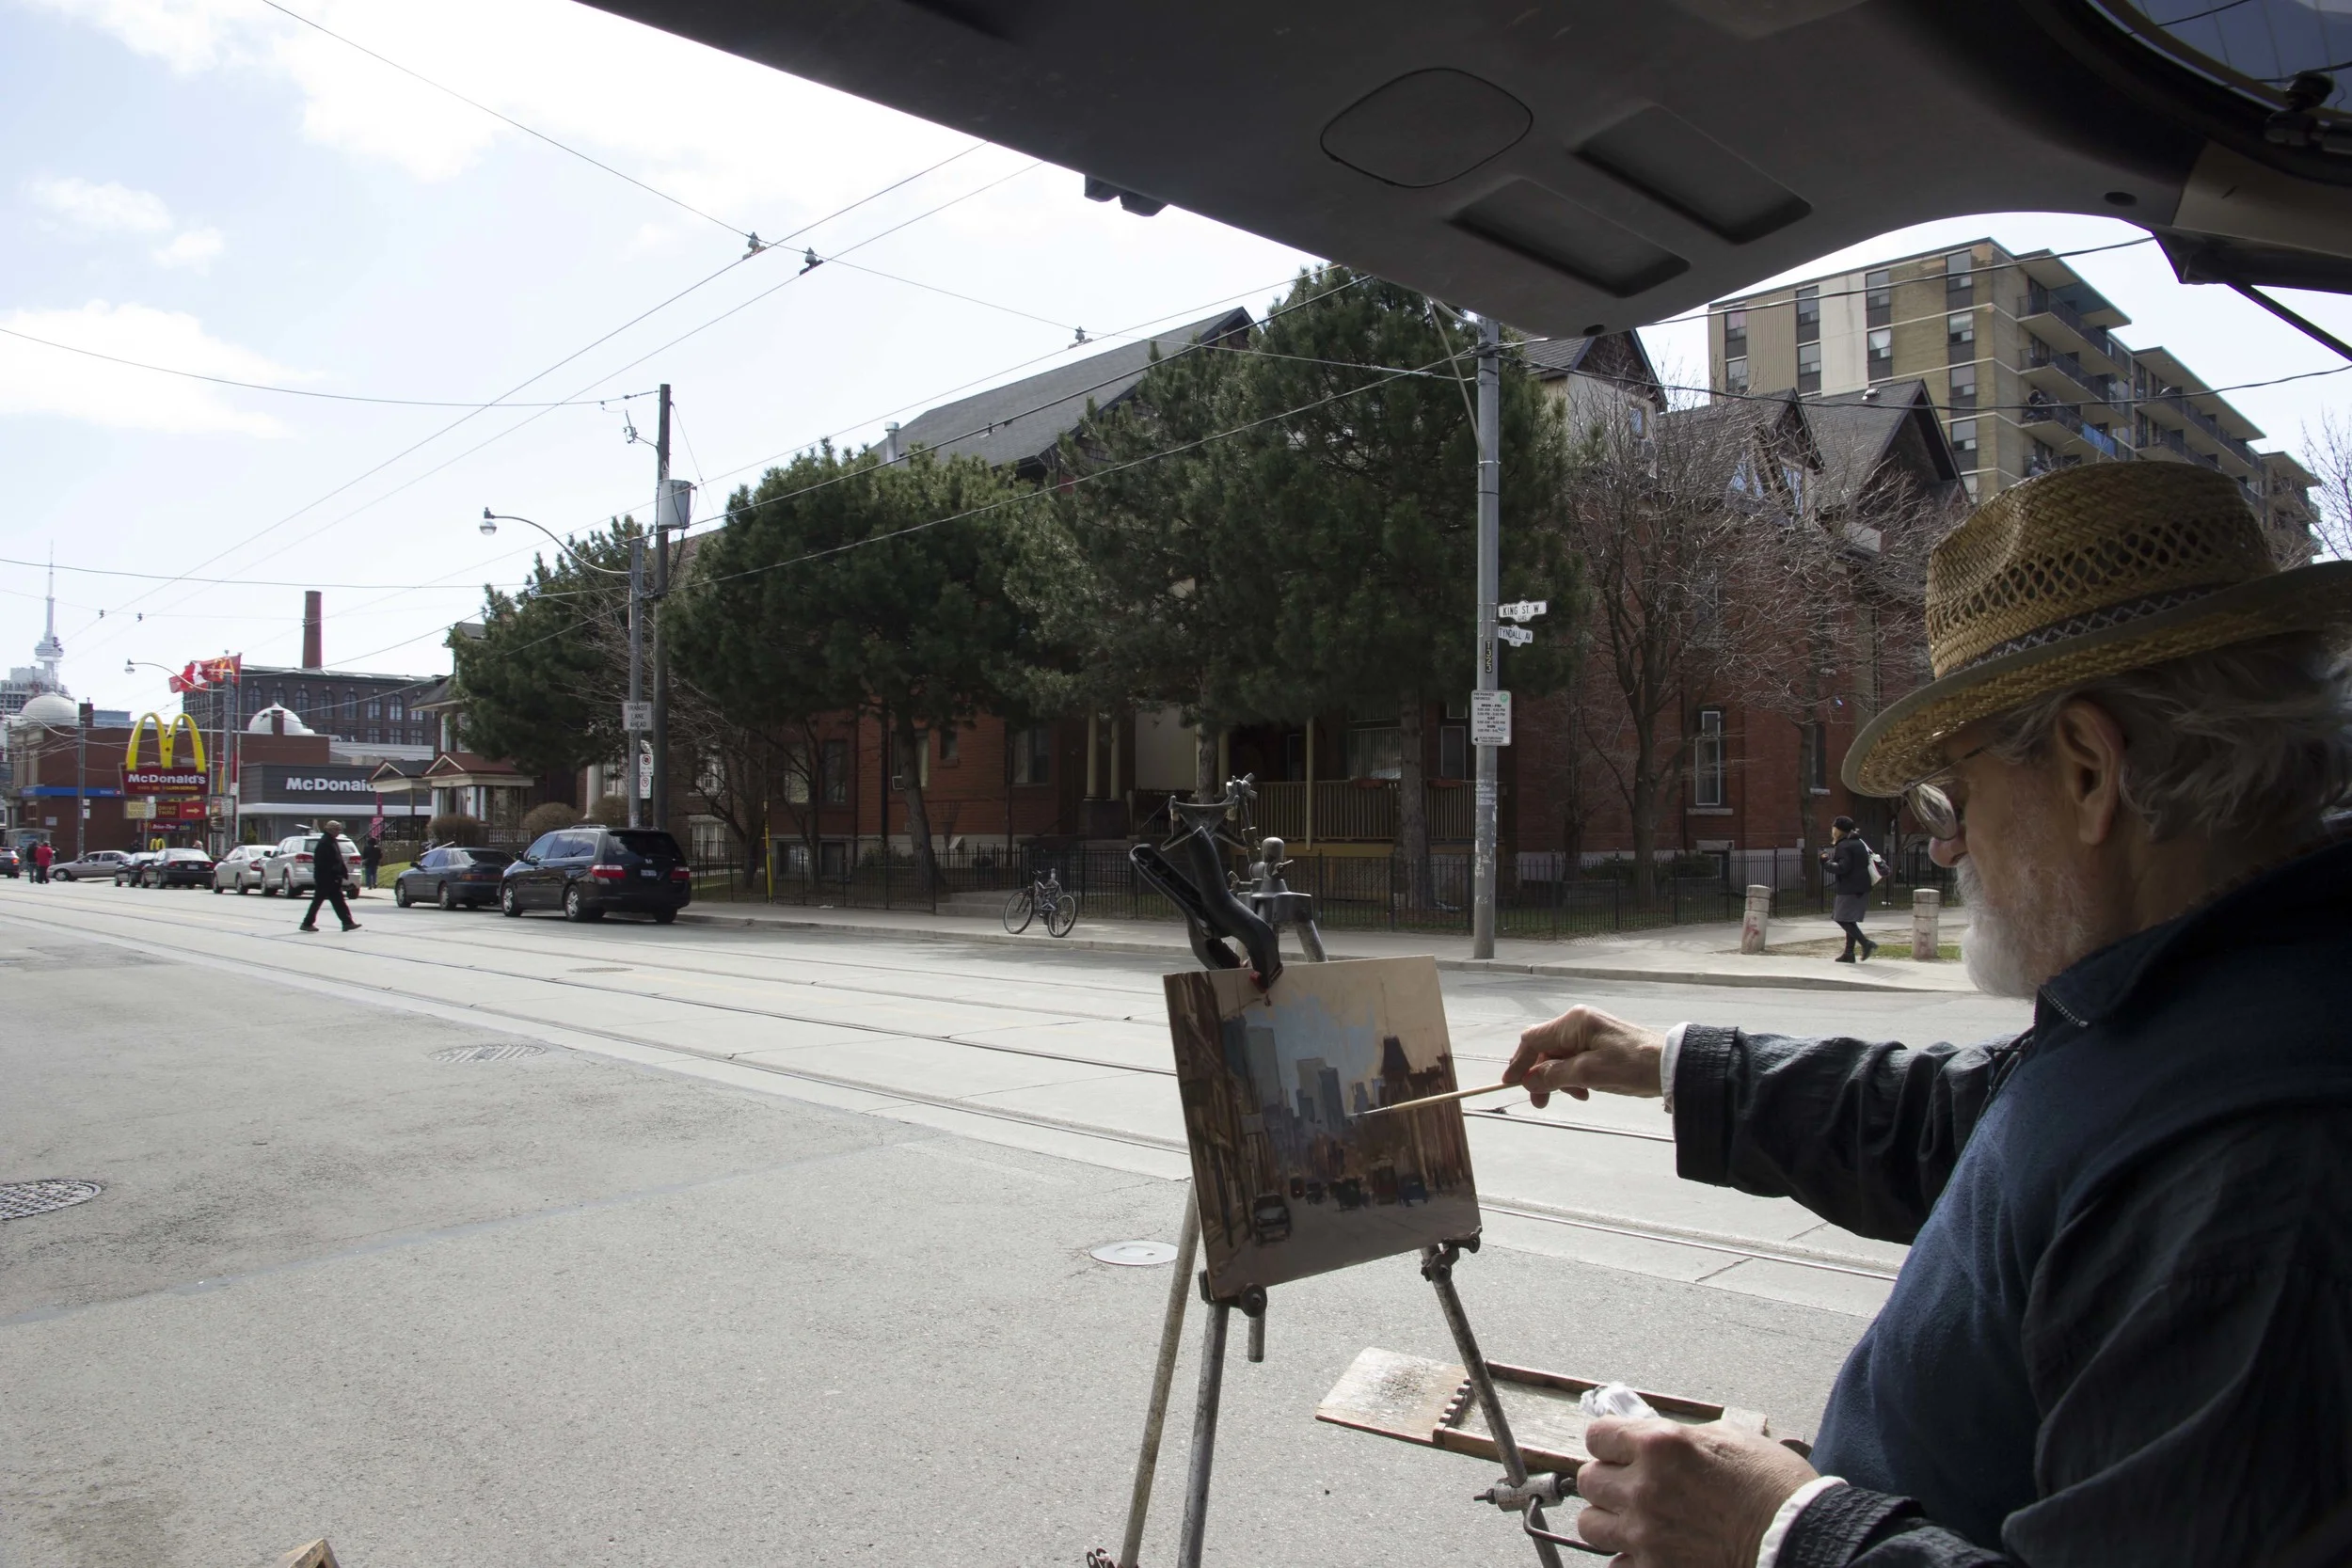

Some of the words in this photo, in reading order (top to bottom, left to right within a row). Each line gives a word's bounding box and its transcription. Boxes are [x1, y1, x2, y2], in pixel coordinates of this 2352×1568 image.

[1502, 606, 1518, 616] KING
[1499, 627, 1521, 640] TYNDALL
[128, 773, 206, 784] McDonald's
